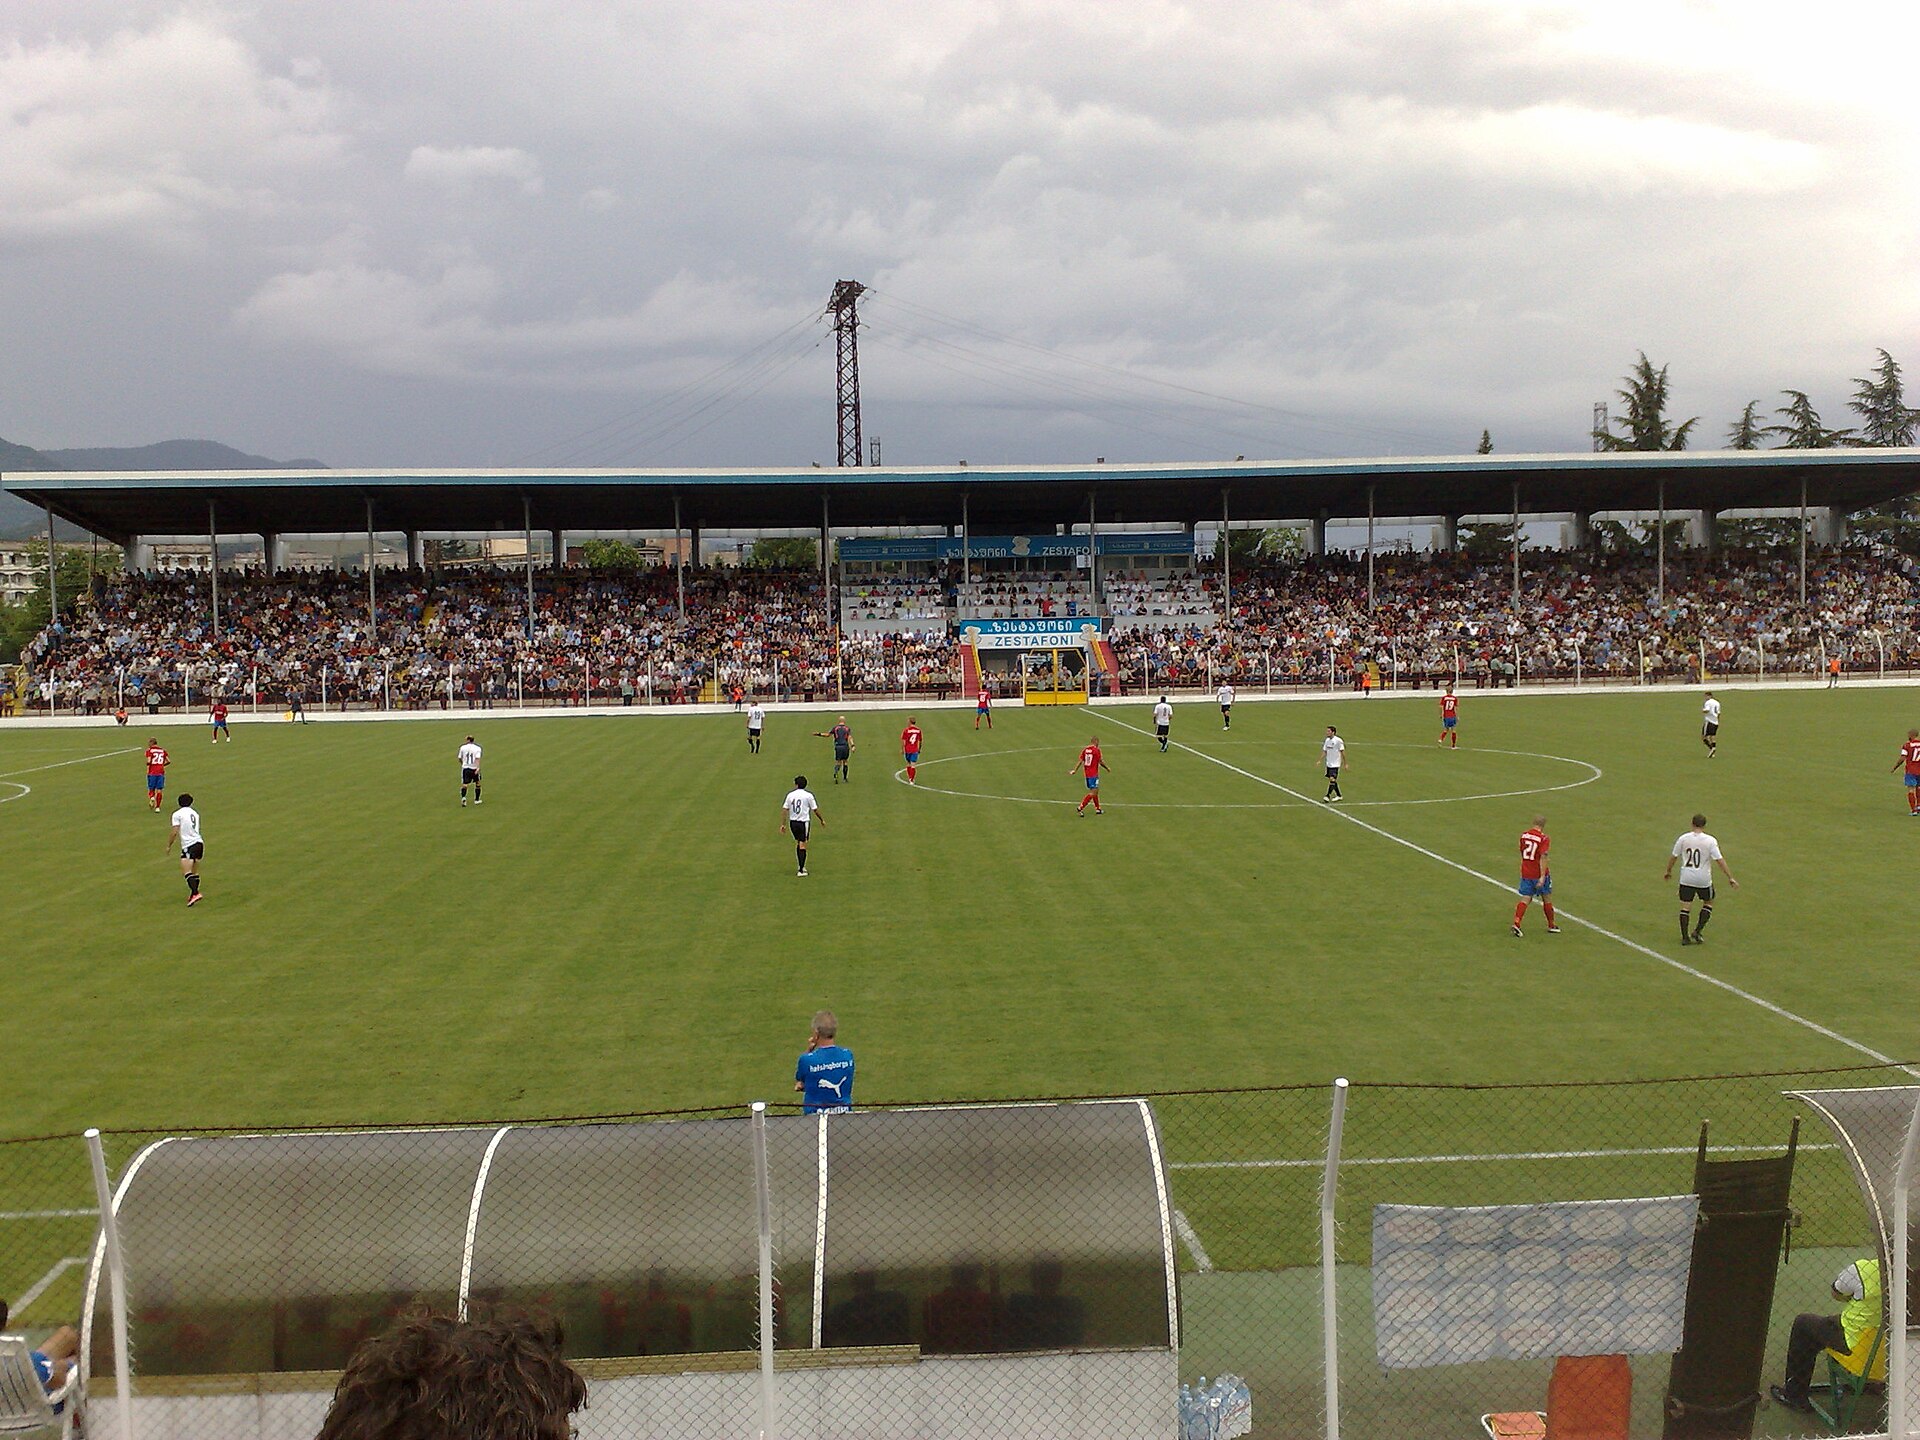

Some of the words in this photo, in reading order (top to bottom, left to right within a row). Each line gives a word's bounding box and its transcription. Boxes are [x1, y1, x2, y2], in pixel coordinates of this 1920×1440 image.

[992, 620, 1073, 632] ზესტაფონი
[995, 635, 1073, 646] ZESTAFONI
[909, 733, 917, 745] 4
[151, 752, 164, 765] 26
[466, 751, 474, 765] 11
[791, 798, 802, 815] 18
[190, 813, 197, 830] 9
[1523, 840, 1538, 861] 21
[1685, 848, 1701, 868] 20
